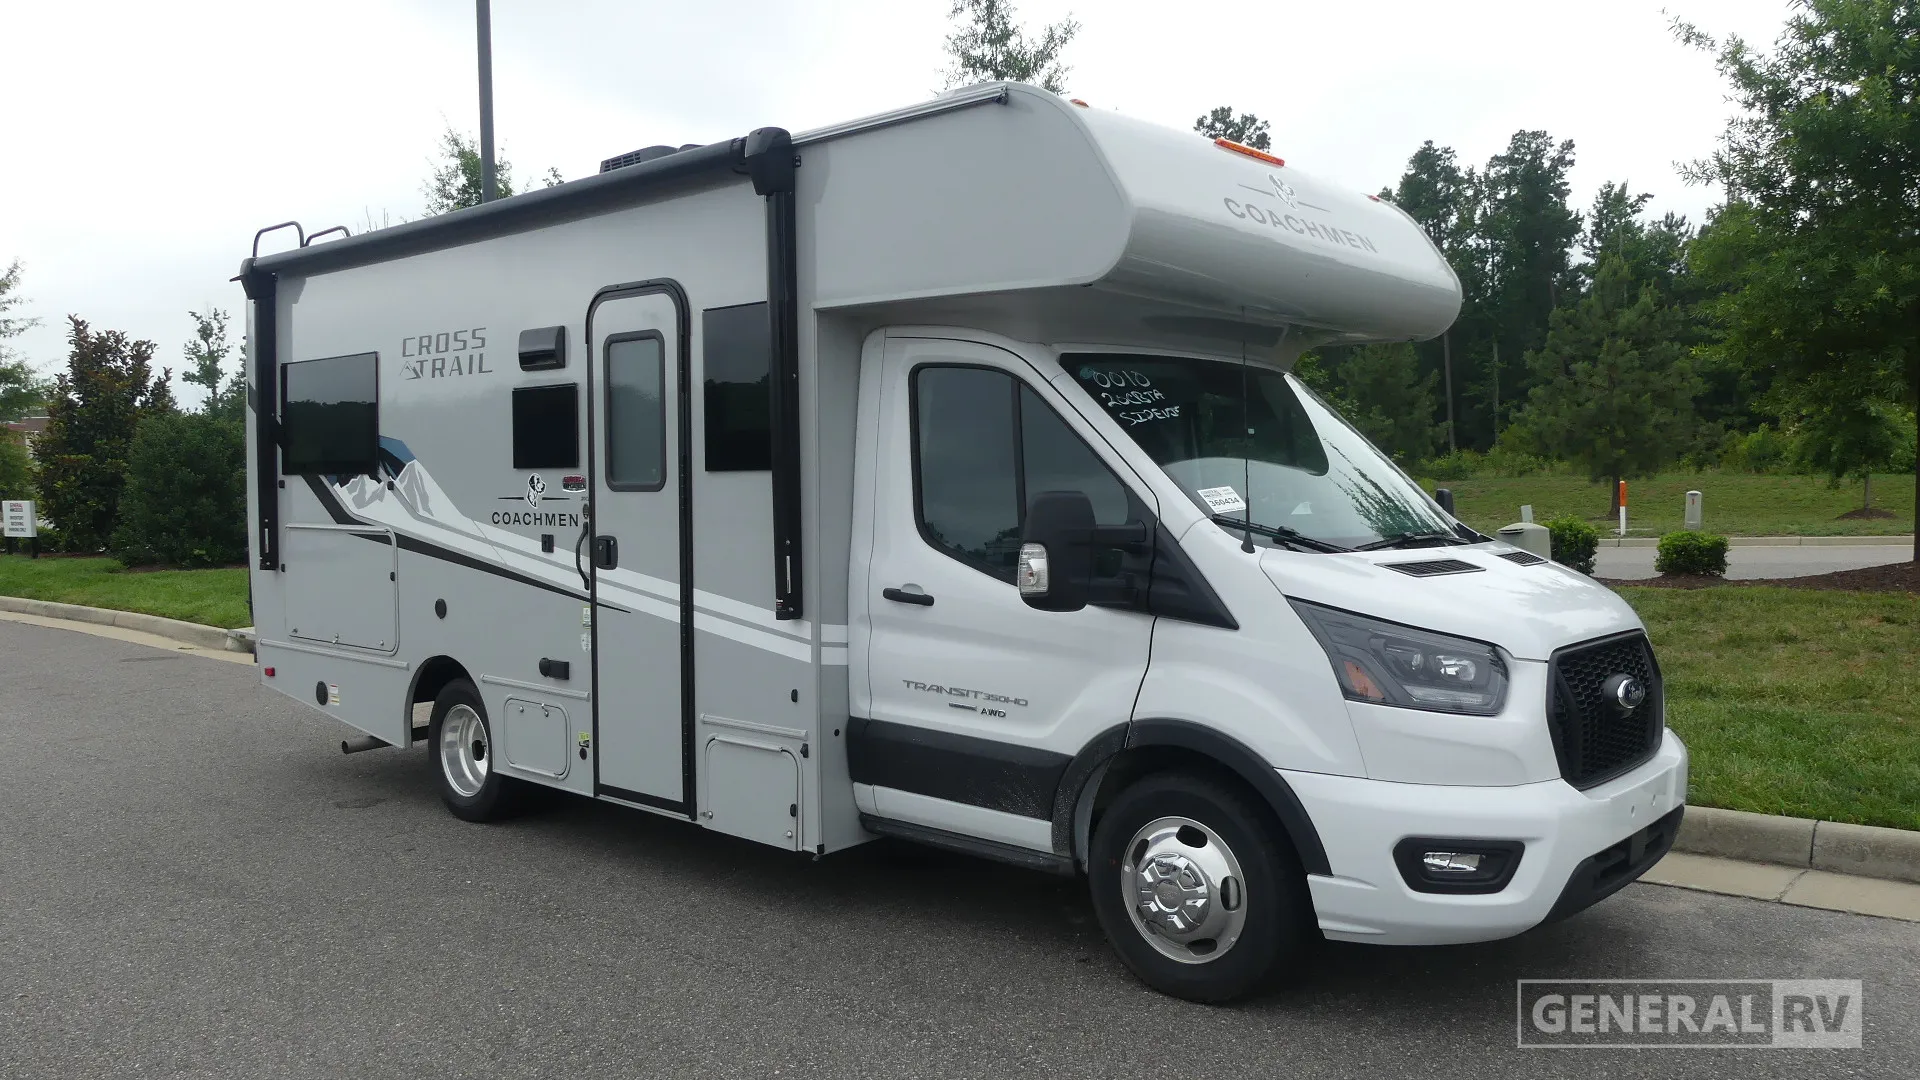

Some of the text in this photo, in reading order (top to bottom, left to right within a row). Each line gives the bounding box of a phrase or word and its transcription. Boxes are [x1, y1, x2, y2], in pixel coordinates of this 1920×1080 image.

[1223, 197, 1378, 253] COACHMEN
[402, 327, 486, 357] CROSS
[415, 353, 493, 379] TRAIL
[1208, 497, 1240, 507] 360434
[492, 511, 579, 527] COACHMEN
[902, 679, 983, 699] TRANSIT
[980, 707, 1007, 719] AWD
